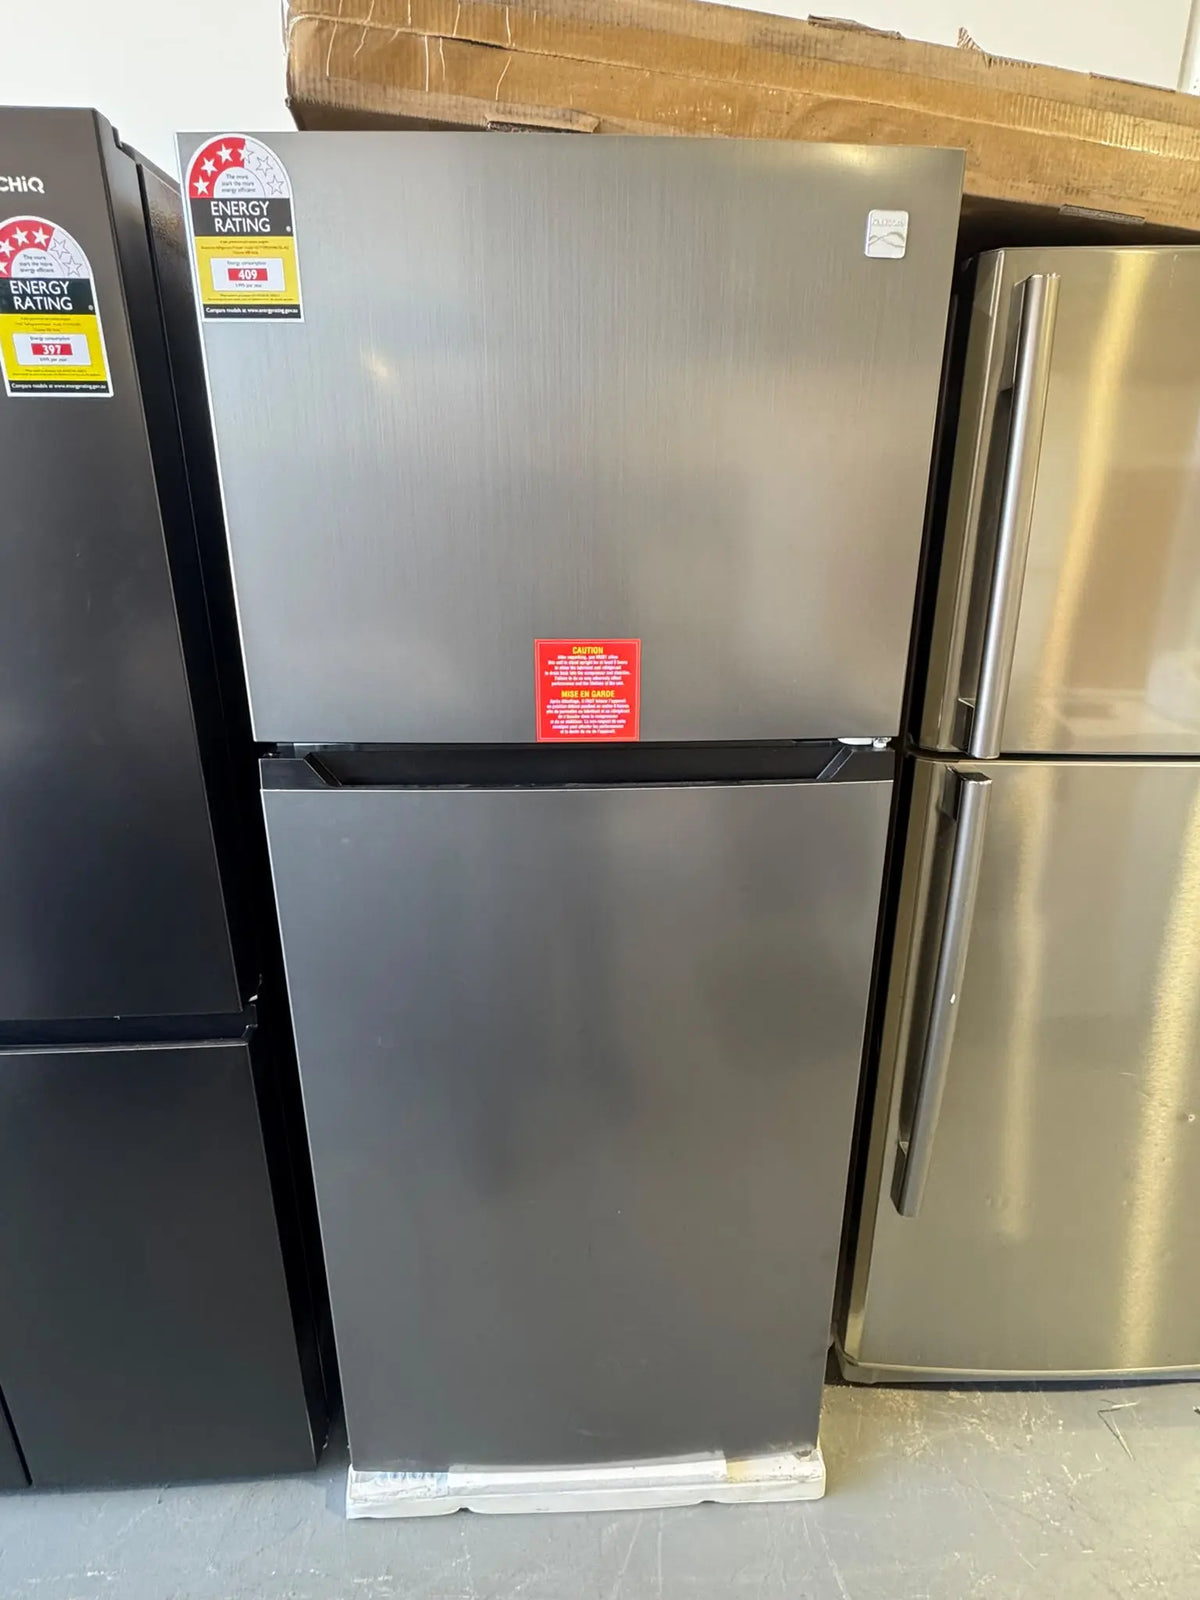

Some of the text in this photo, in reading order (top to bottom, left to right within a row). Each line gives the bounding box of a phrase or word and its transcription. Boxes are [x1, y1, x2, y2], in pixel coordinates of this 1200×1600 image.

[210, 201, 270, 216] ENERGY
[214, 218, 271, 233] RATING
[238, 269, 258, 280] 409
[9, 280, 69, 295] ENERGY
[13, 296, 73, 310] RATING
[42, 344, 62, 355] 397
[572, 646, 604, 655] CAUTION
[561, 690, 615, 698] MISE EN GARDE
